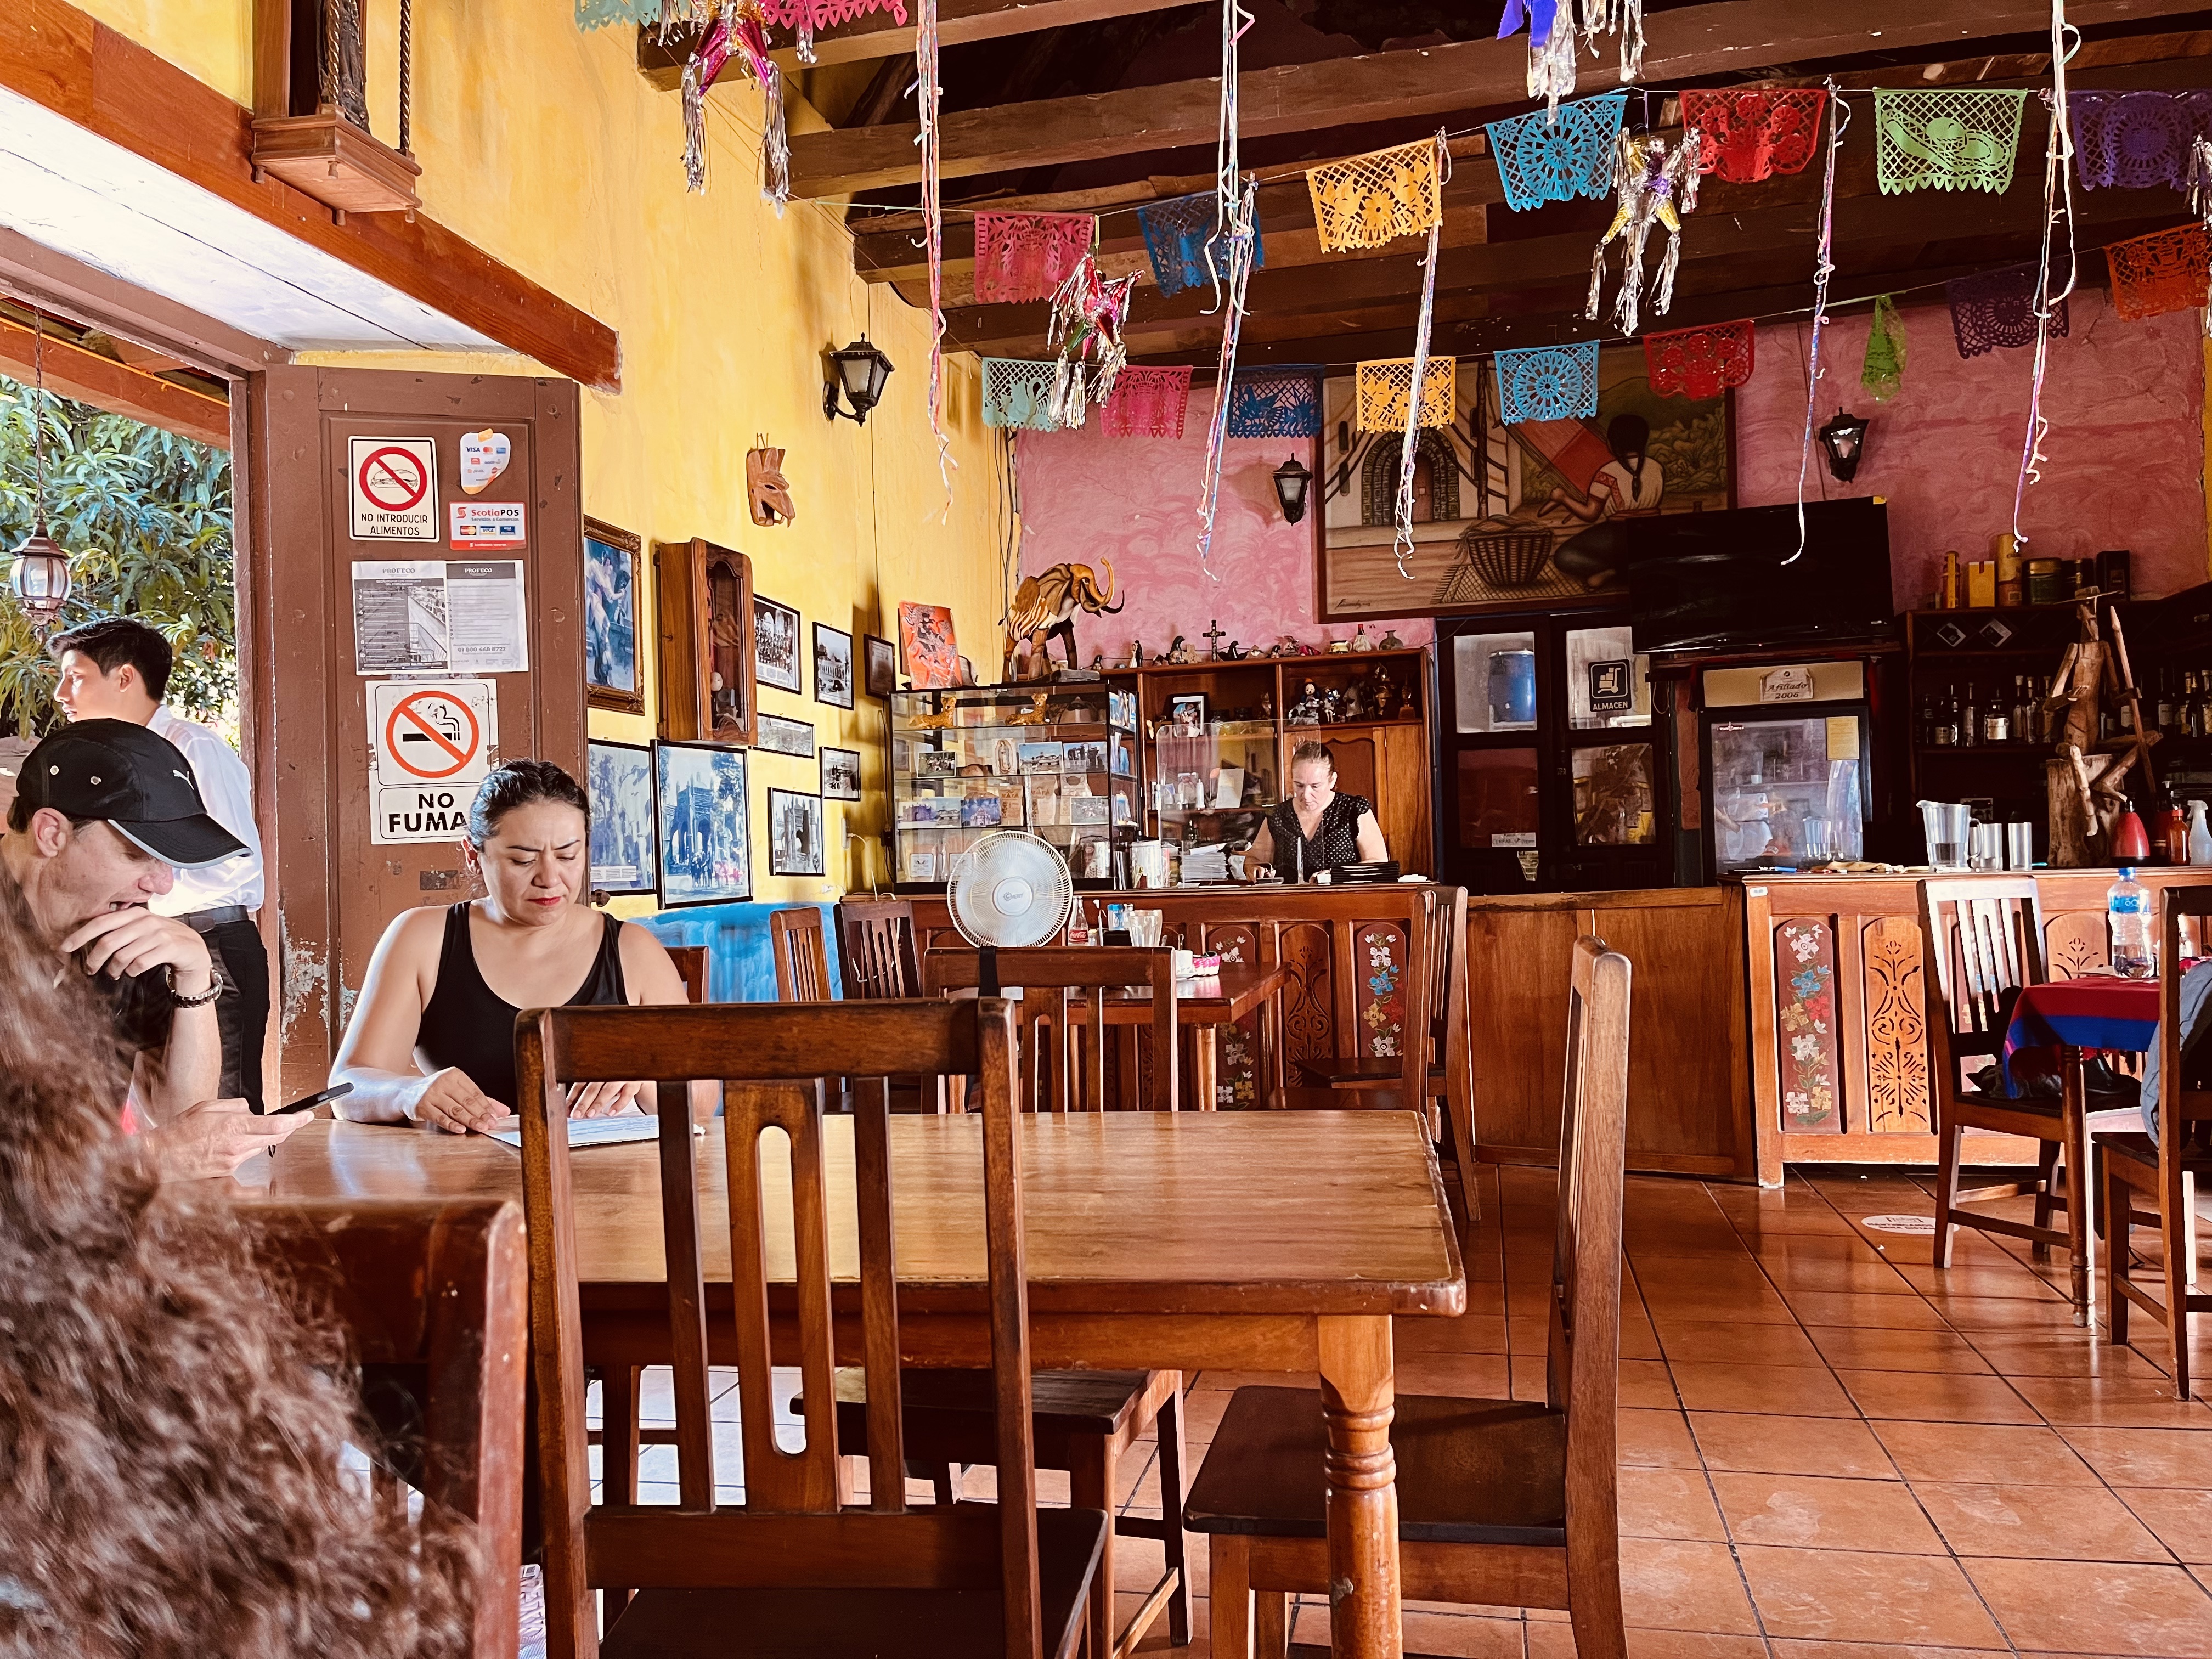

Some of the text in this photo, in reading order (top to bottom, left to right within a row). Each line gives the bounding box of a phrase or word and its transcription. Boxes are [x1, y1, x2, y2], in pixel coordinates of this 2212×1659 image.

[377, 514, 428, 523] INTRODUCIR
[370, 526, 420, 535] ALIMENTOS
[1767, 682, 1807, 692] Afiliado
[1593, 701, 1628, 710] ALMACEN
[419, 793, 454, 809] NO
[388, 812, 467, 833] FUMA
